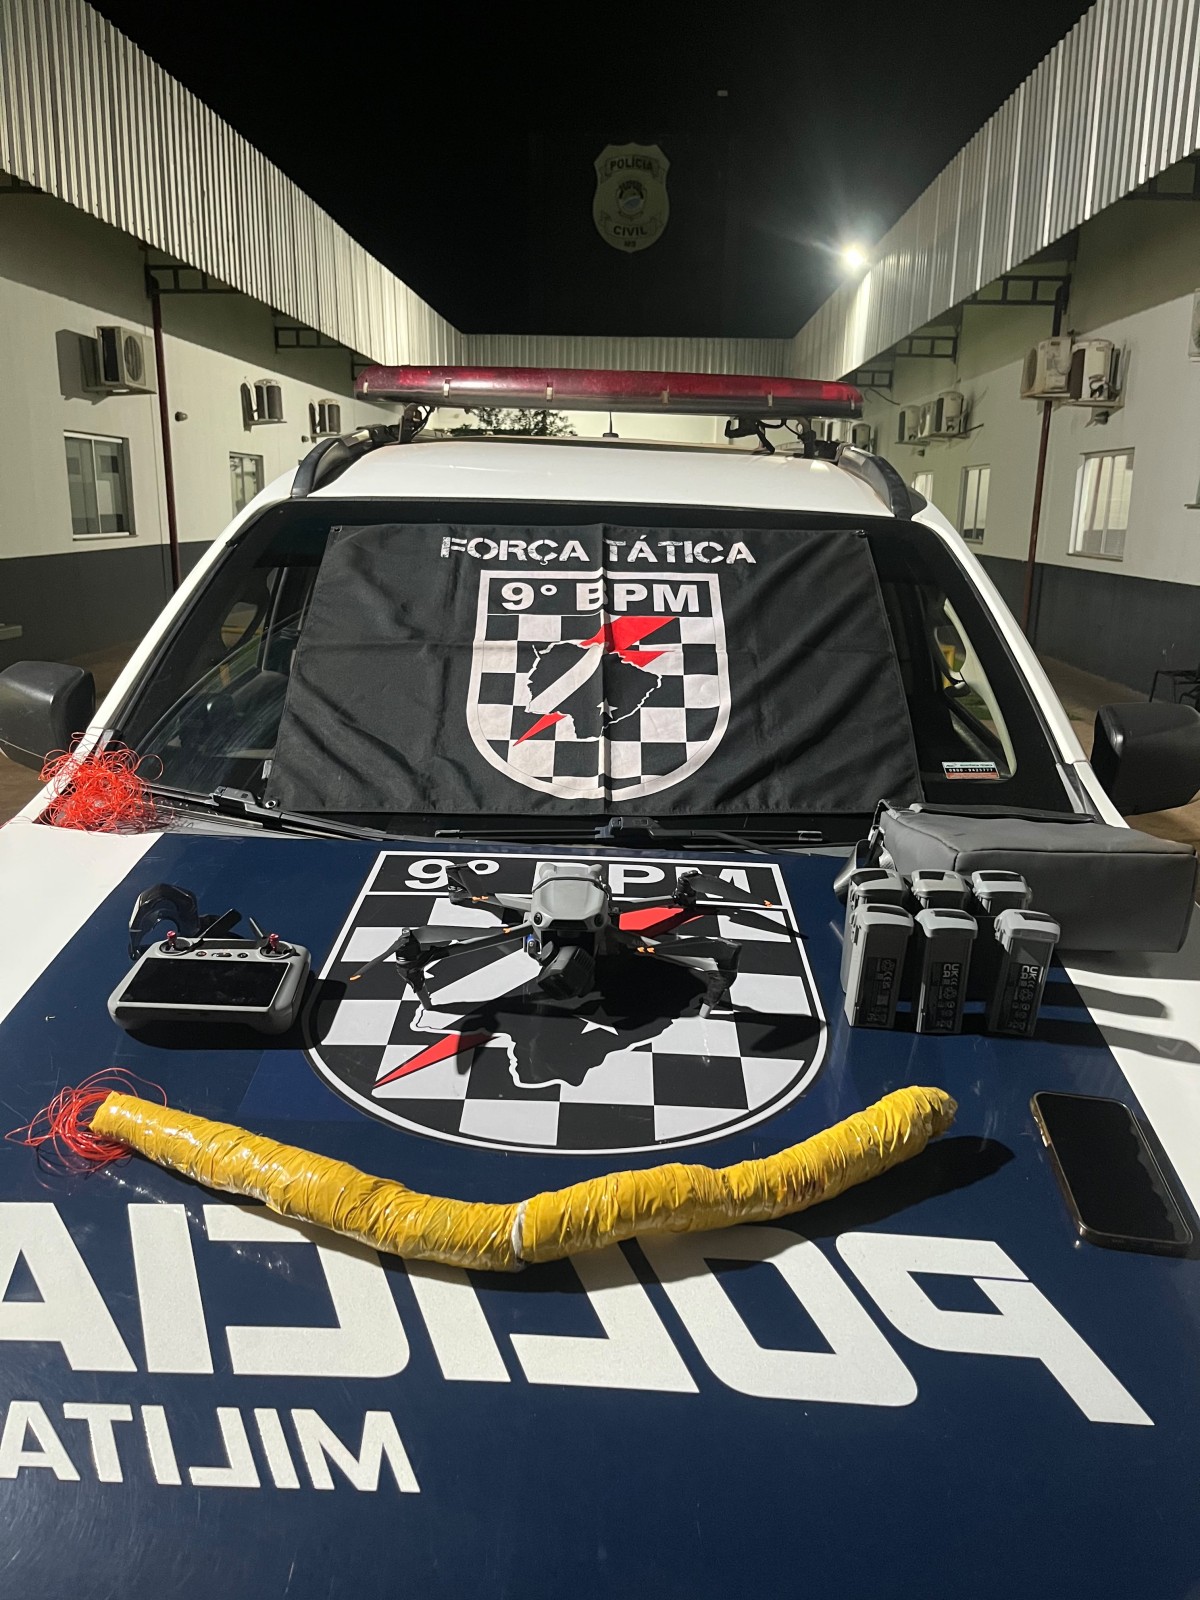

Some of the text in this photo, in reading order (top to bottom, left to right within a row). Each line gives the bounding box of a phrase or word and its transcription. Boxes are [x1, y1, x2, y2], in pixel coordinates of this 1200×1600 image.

[613, 225, 648, 237] CIVIL
[440, 534, 757, 566] FORÇA TÁTICA
[575, 582, 700, 613] BPM
